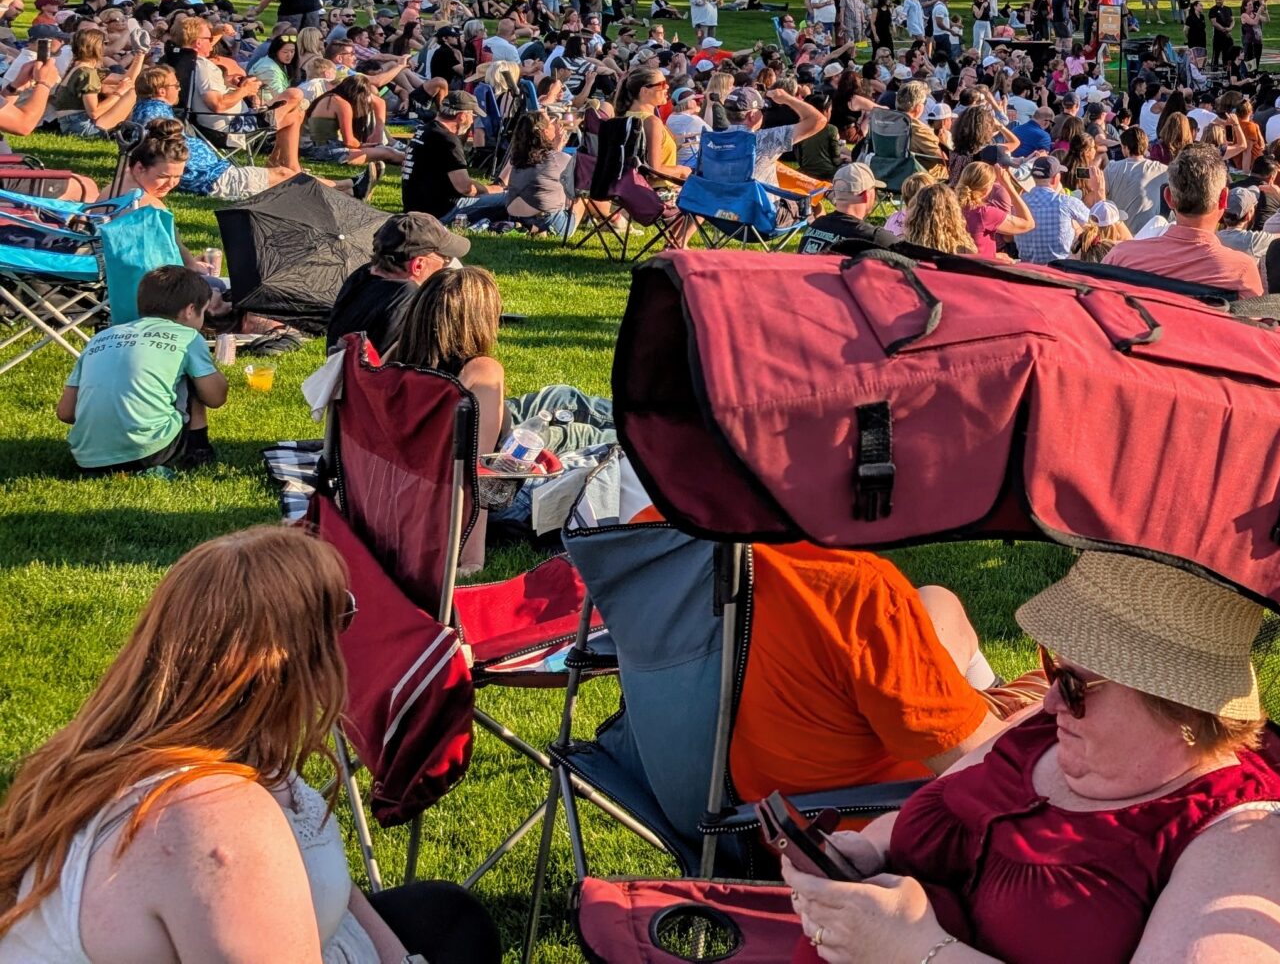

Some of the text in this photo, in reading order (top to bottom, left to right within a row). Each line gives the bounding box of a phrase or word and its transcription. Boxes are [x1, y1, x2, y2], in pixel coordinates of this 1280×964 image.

[94, 331, 179, 346] Heritage BASE
[88, 344, 106, 356] 303
[115, 340, 137, 349] 579
[148, 340, 177, 352] 7670
